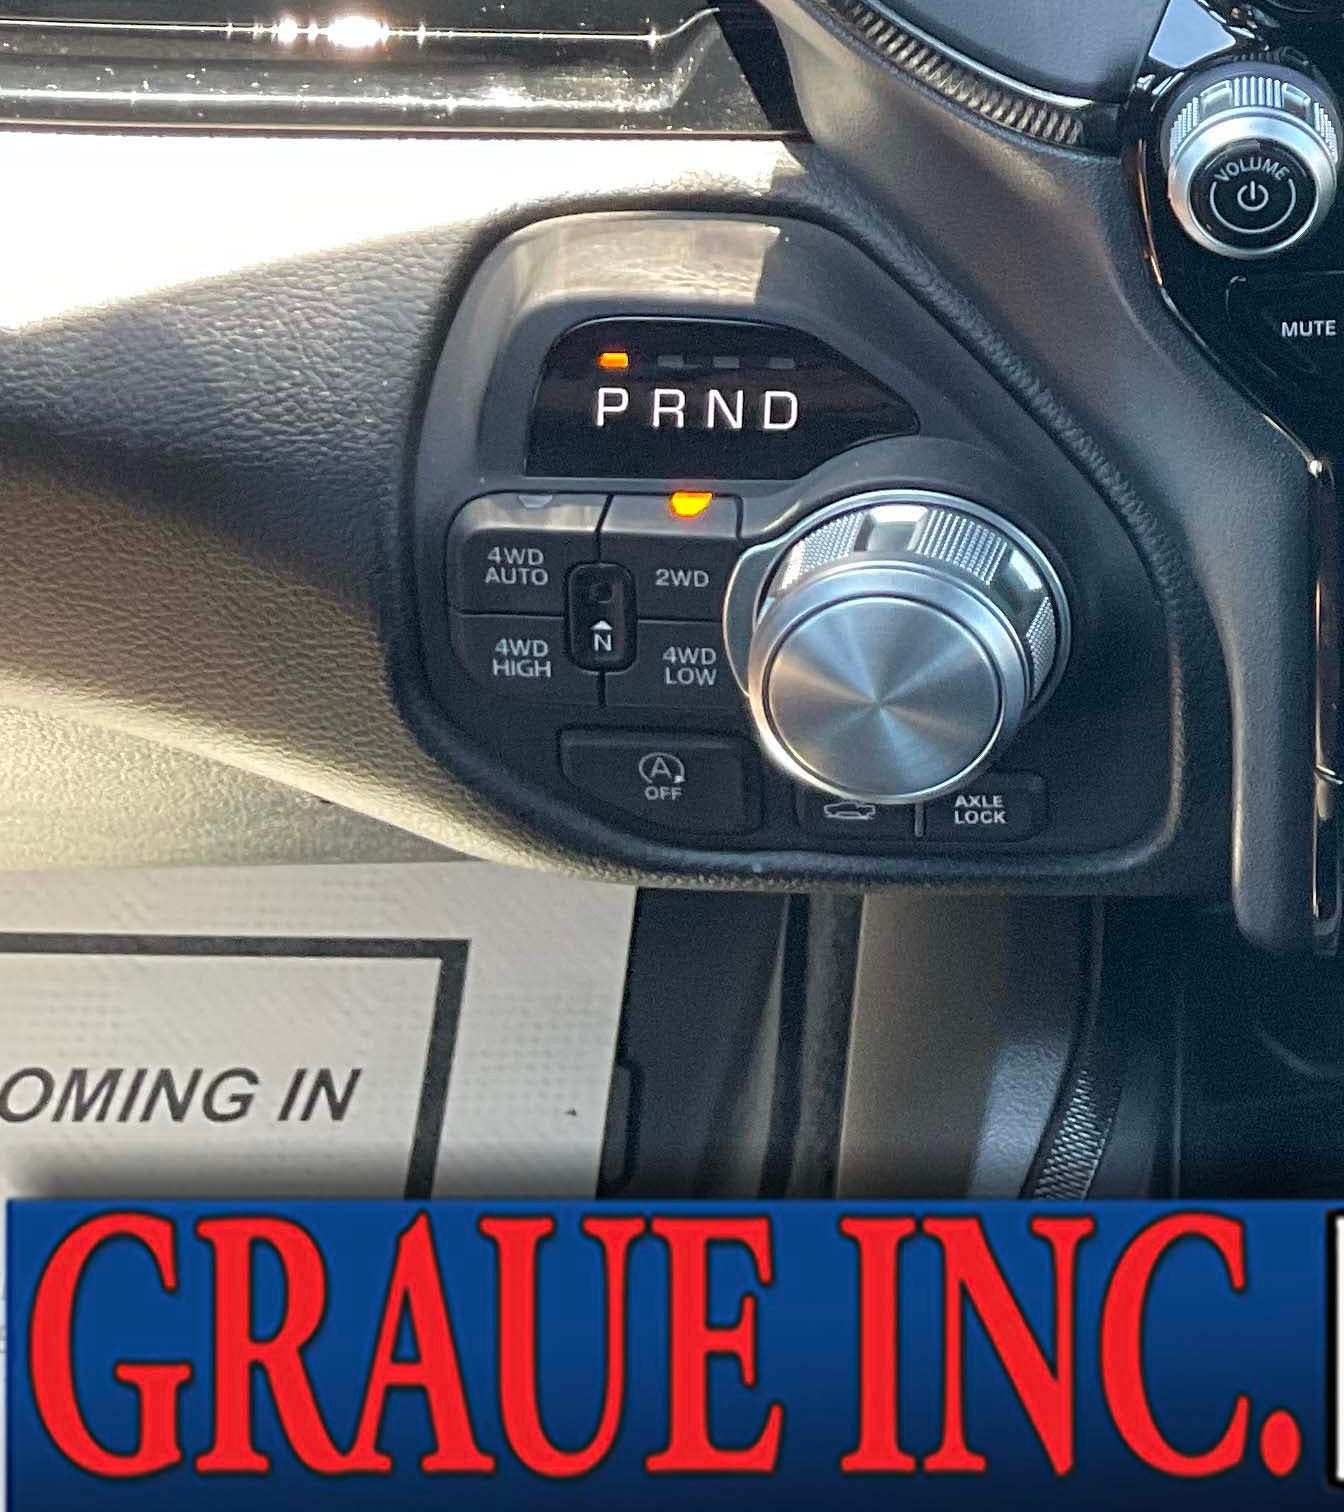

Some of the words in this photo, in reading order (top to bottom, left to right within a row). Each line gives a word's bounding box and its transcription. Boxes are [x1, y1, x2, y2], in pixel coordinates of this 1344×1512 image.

[1214, 157, 1290, 182] VOLUME
[1281, 320, 1336, 337] MUTE
[487, 546, 544, 566] 4WD
[484, 566, 549, 586] AUTO
[655, 569, 710, 588] 2WD
[495, 638, 549, 658] 4WD
[594, 631, 611, 652] N
[662, 646, 717, 666] 4WD
[492, 658, 551, 679] HIGH
[665, 665, 717, 687] LOW
[645, 786, 683, 801] OFF
[954, 794, 1004, 810] AXLE
[954, 808, 1006, 825] LOCK
[0, 1067, 260, 1123] OMING
[277, 1068, 362, 1122] IN
